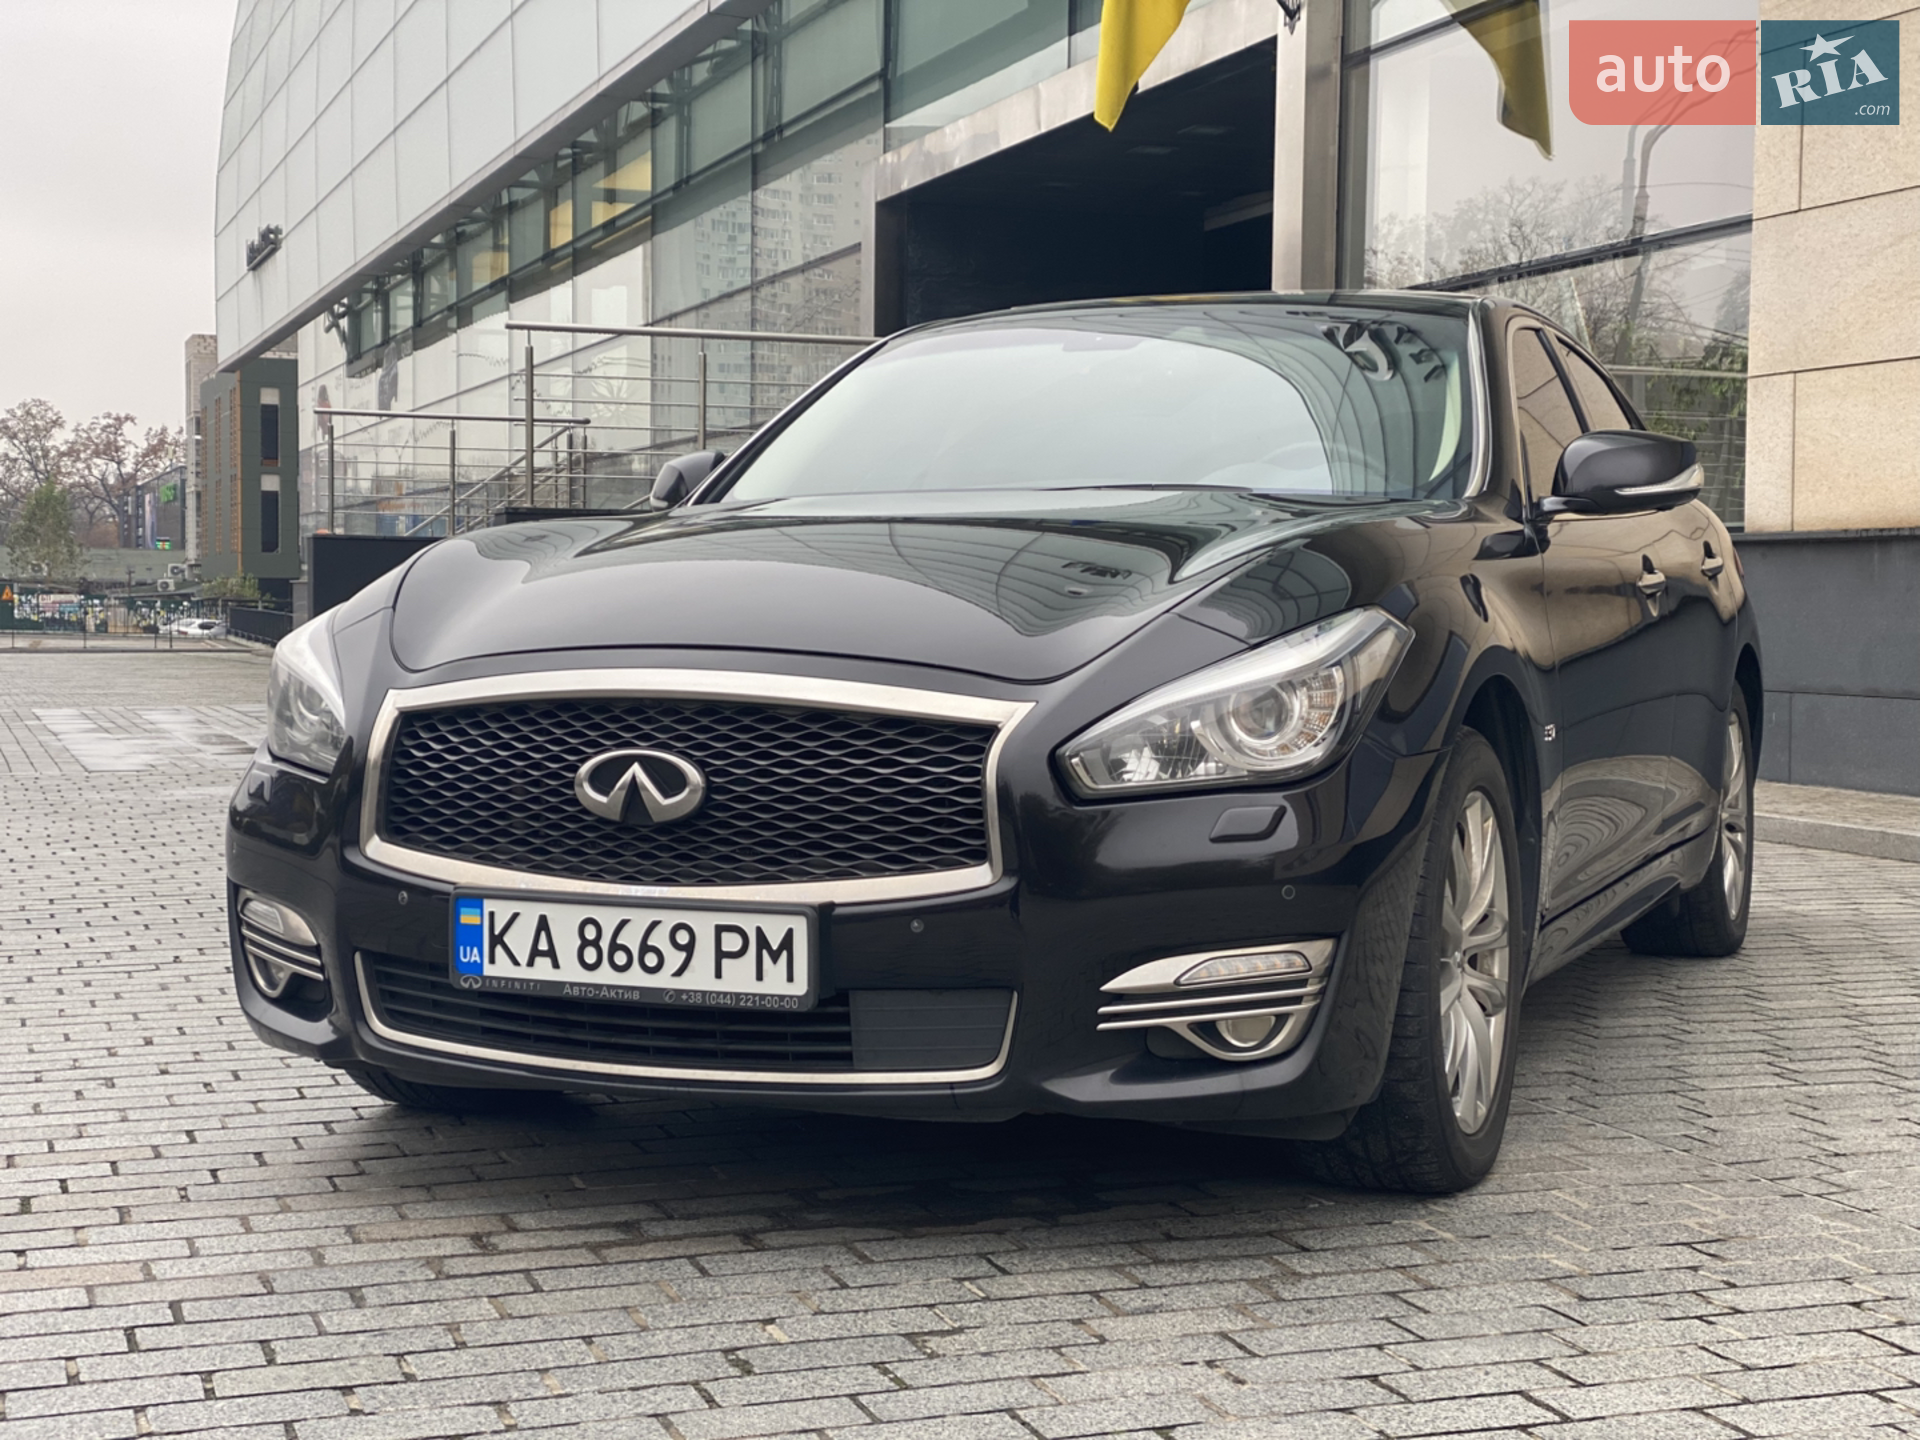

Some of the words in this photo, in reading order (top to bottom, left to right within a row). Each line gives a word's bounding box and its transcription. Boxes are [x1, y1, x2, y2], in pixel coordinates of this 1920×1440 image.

[459, 945, 481, 964] UA
[487, 910, 560, 969] KA
[577, 916, 697, 977] 8669
[714, 924, 795, 983] PM
[485, 978, 541, 991] INFINITI
[680, 992, 702, 1004] +38
[705, 993, 736, 1006] (044)
[739, 995, 799, 1009] 221-00-00
